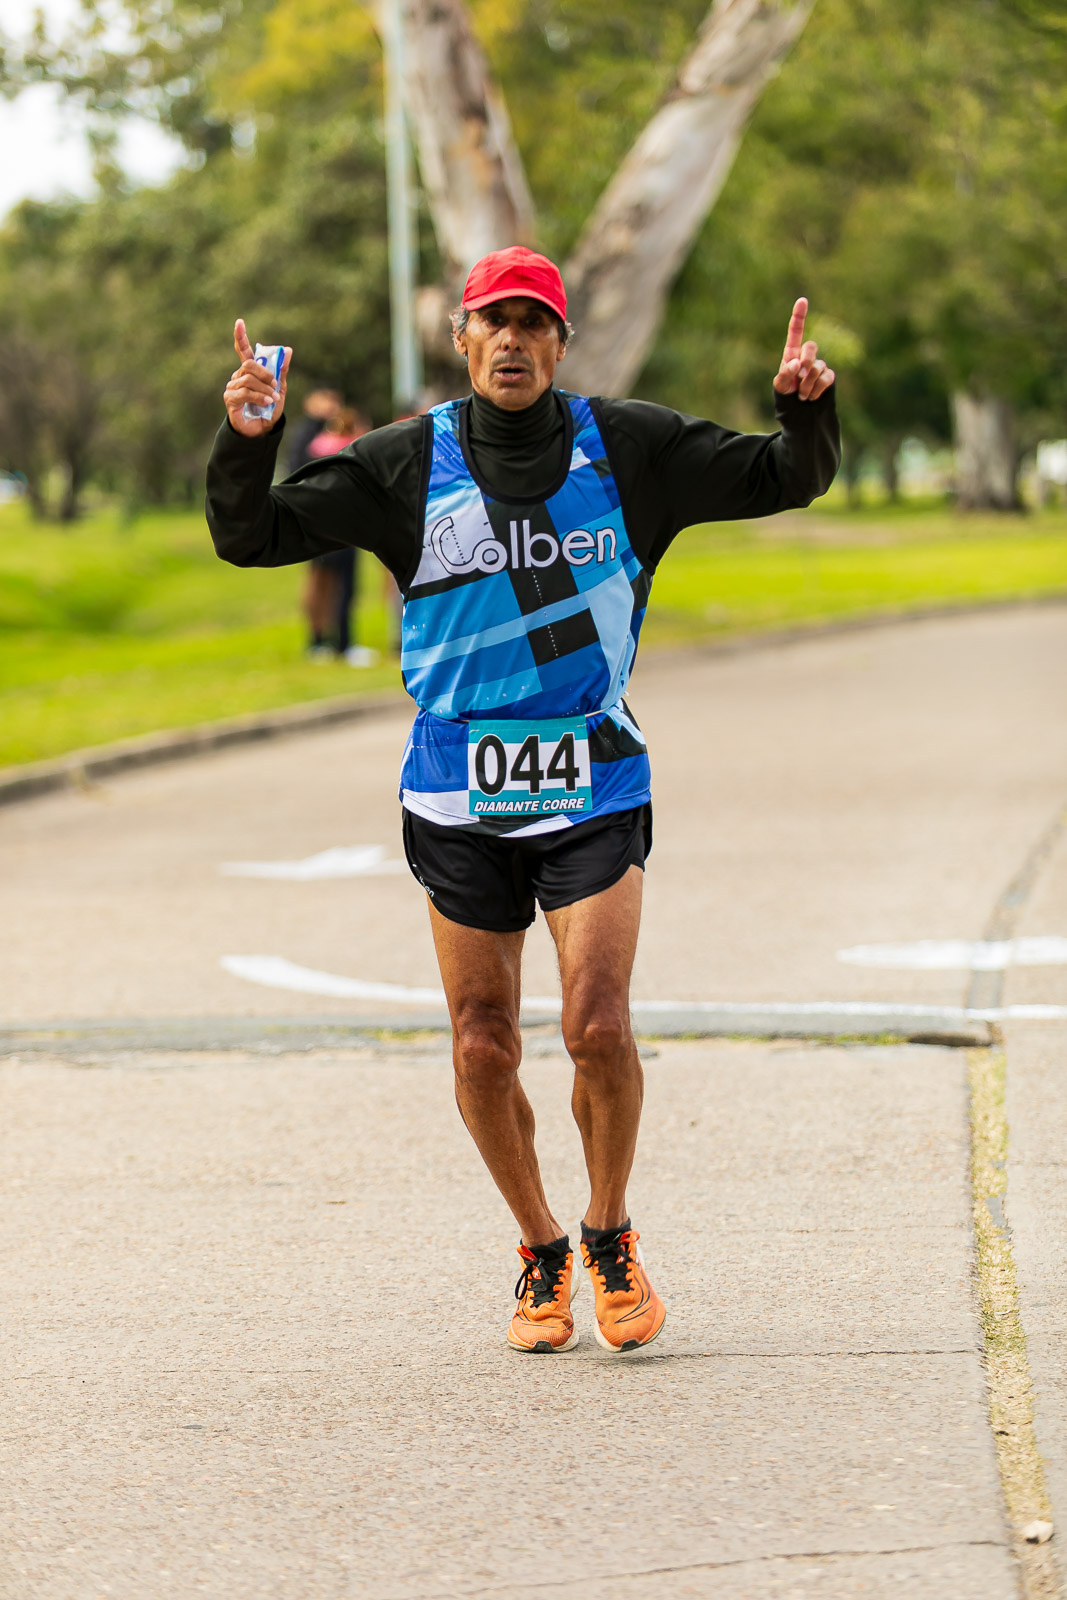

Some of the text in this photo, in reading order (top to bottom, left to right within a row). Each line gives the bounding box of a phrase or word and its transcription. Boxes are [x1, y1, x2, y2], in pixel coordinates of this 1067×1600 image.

[431, 516, 617, 574] Colben
[475, 732, 580, 795] 044
[473, 797, 586, 813] DIAMANTE CORRE
